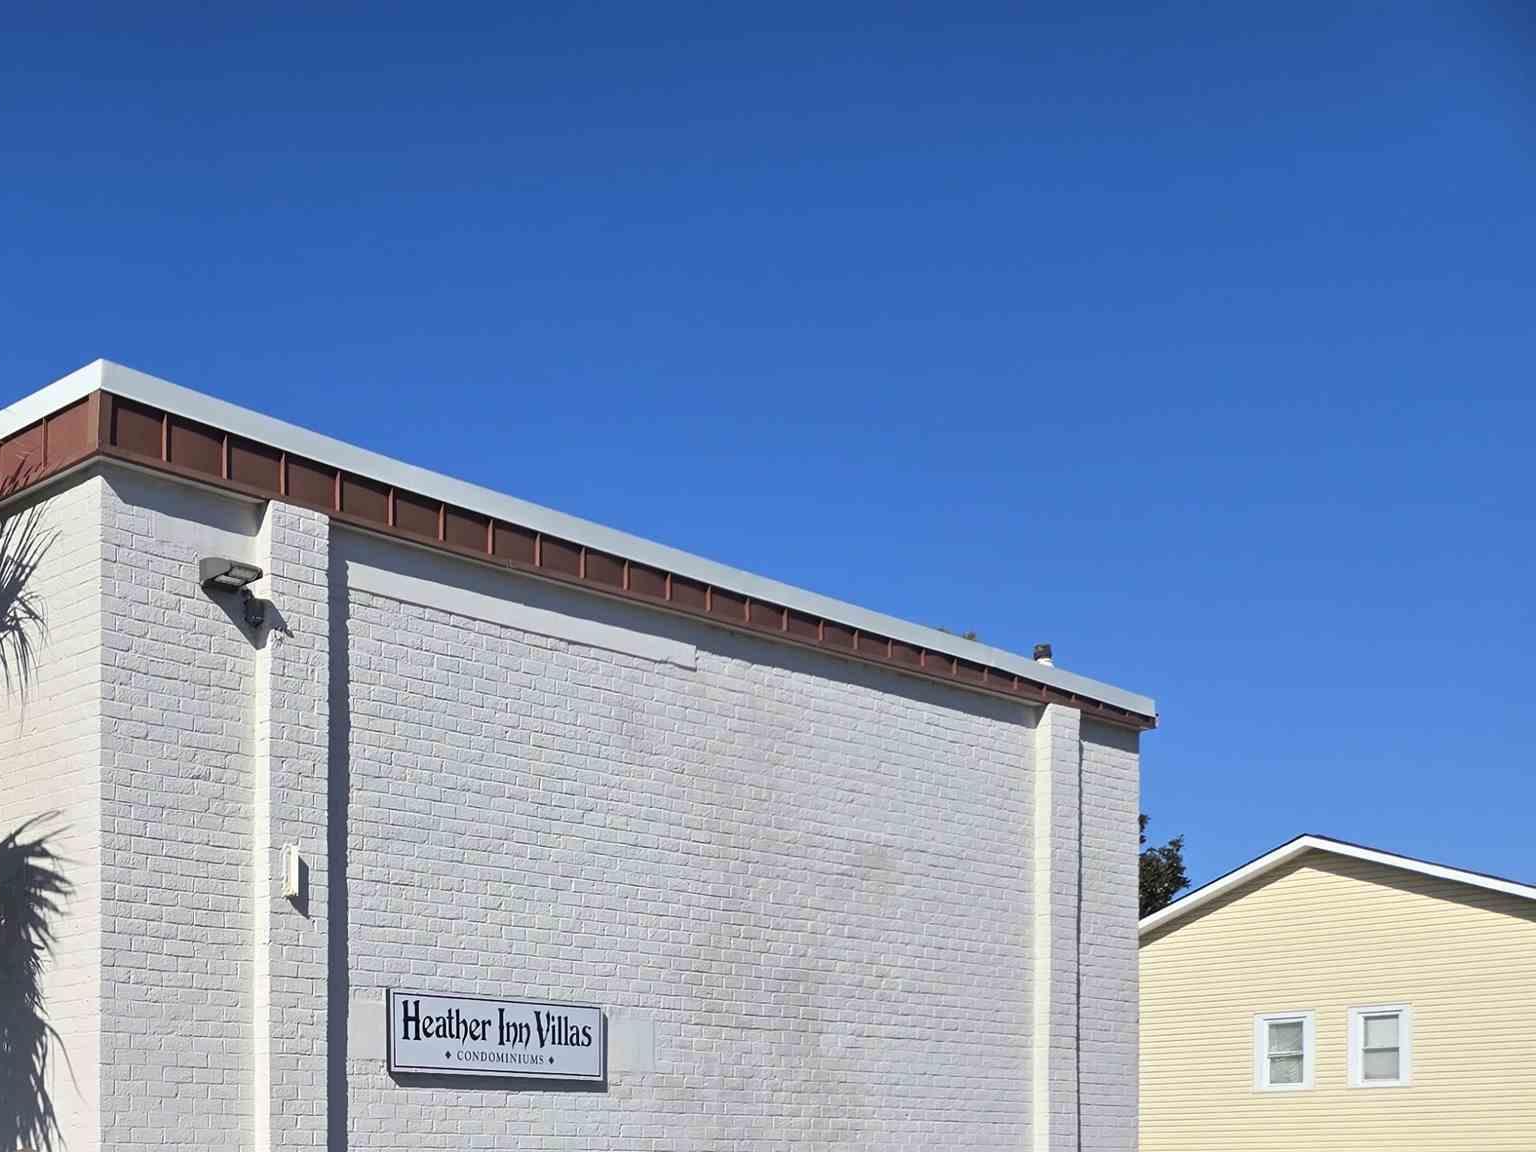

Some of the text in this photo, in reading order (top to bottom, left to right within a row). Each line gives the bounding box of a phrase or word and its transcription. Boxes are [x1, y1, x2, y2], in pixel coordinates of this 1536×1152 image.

[402, 999, 592, 1050] Heather Inn Villas
[456, 1049, 546, 1065] CONDOMINIUMS
